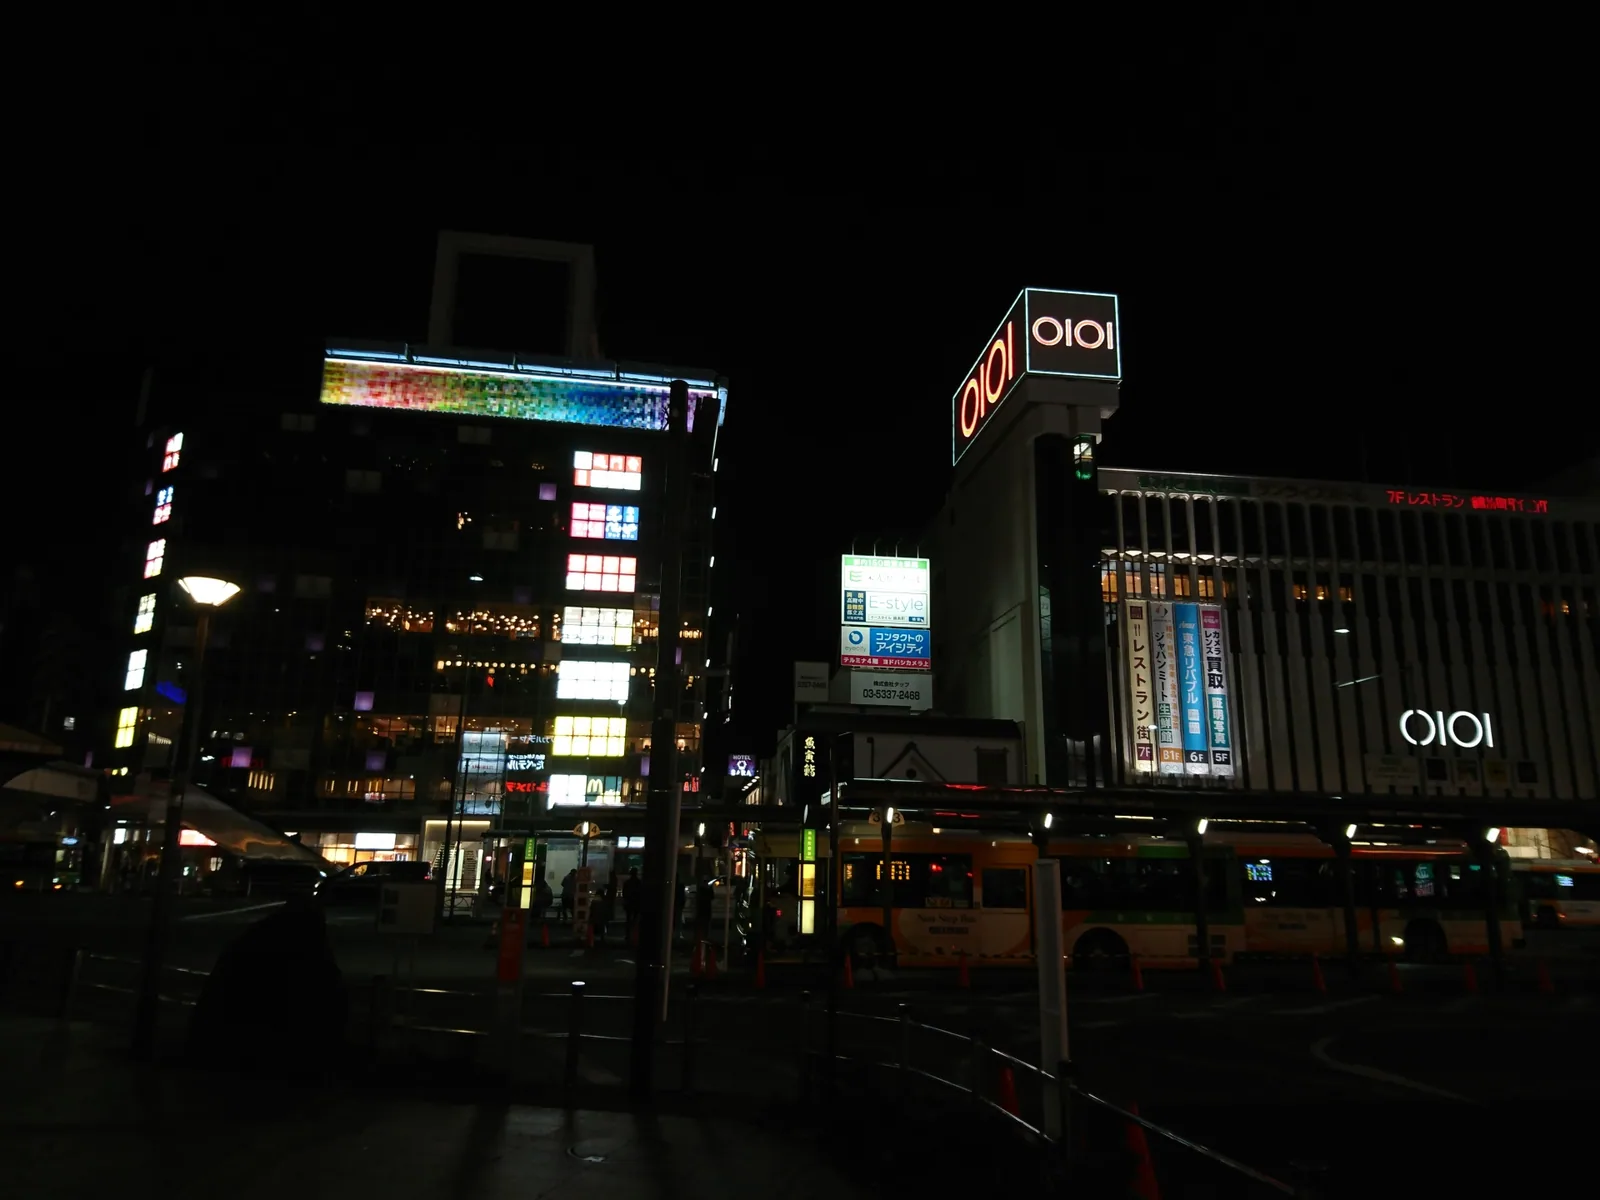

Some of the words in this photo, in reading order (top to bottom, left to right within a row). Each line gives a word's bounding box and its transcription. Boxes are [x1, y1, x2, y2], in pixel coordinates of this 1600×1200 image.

[869, 595, 924, 613] E-style
[876, 633, 924, 643] コンタクトの
[1211, 630, 1222, 655] カメラ
[876, 642, 924, 655] アイシティ
[882, 659, 929, 667] ヨドバシカメラ上
[1182, 633, 1199, 704] 東急リバブル
[1206, 656, 1224, 689] 買取
[863, 689, 920, 700] 03-5337-2468
[1133, 639, 1150, 740] レストラン街
[1211, 697, 1226, 744] 証明写真
[1138, 746, 1151, 757] 7F
[1163, 749, 1180, 760] B1F
[1190, 752, 1204, 762] 6F
[1215, 752, 1229, 762] 5F
[872, 812, 880, 822] 3
[893, 813, 901, 823] 3
